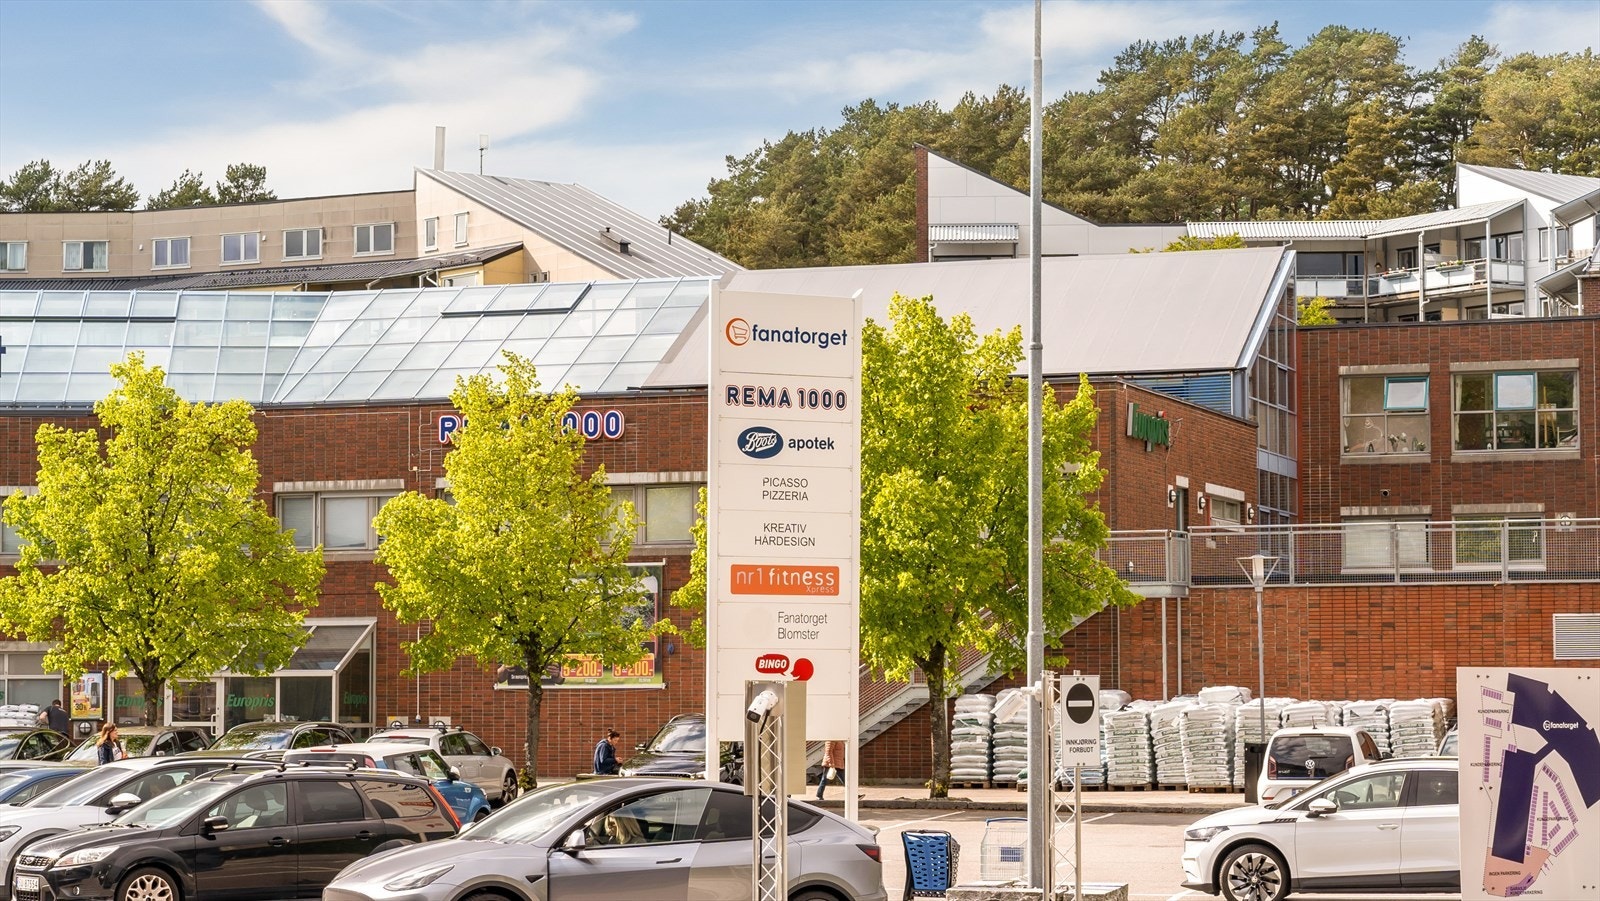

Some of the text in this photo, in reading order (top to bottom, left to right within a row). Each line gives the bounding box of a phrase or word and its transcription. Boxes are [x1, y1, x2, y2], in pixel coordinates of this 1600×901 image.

[752, 324, 848, 349] fanatorget
[725, 384, 848, 411] REMA 1000
[742, 430, 835, 453] Boots apotek
[762, 477, 809, 489] PICASSO
[762, 490, 809, 502] PIZZERIA
[763, 522, 807, 534] KREATIV
[754, 534, 816, 547] HÅRDESIGN
[769, 568, 835, 586] fitness
[806, 586, 835, 595] Xpress
[777, 611, 828, 627] Fanatorget
[777, 627, 820, 640] Blomster
[758, 659, 787, 669] BINGO
[115, 694, 163, 710] Europs
[226, 693, 275, 711] Europris
[1550, 721, 1579, 731] fanatorget
[1065, 738, 1097, 746] INNKJØRING
